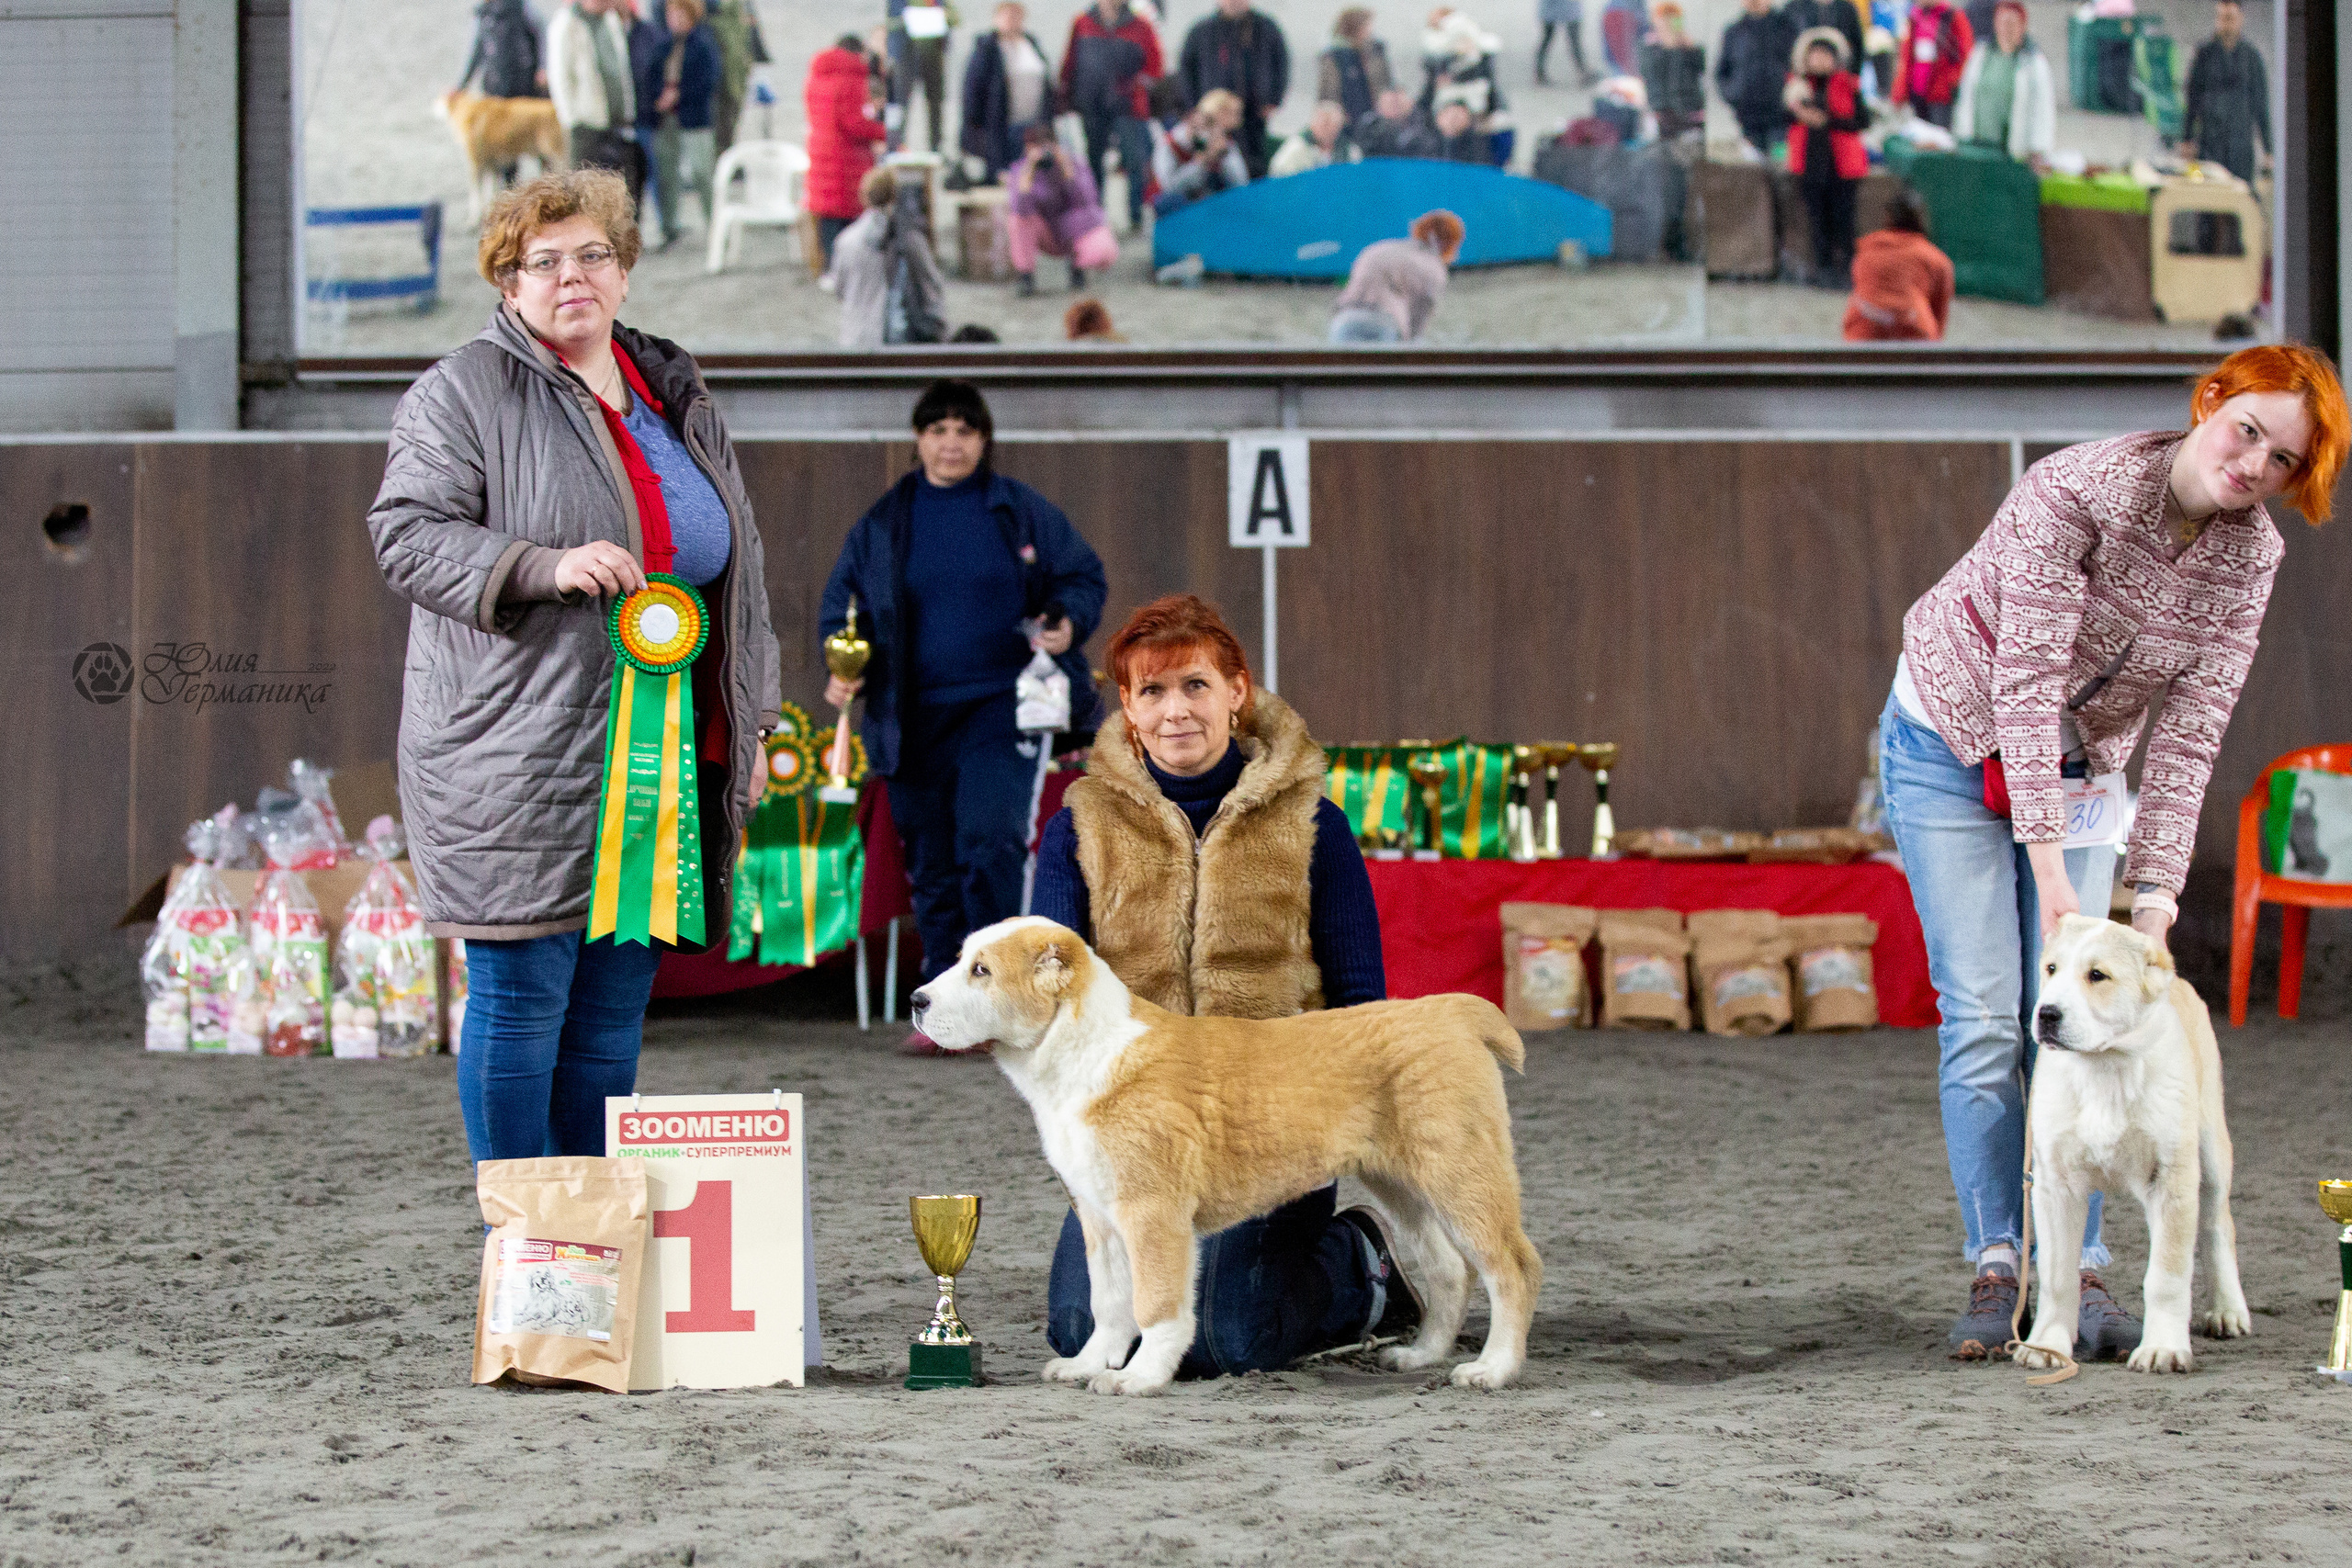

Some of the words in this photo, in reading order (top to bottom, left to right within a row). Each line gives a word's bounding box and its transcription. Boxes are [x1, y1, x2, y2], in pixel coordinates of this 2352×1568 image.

[1246, 448, 1294, 535] A
[2068, 797, 2104, 834] 30
[623, 1114, 786, 1140] ЗООМЕНЮ
[653, 1180, 755, 1332] 1
